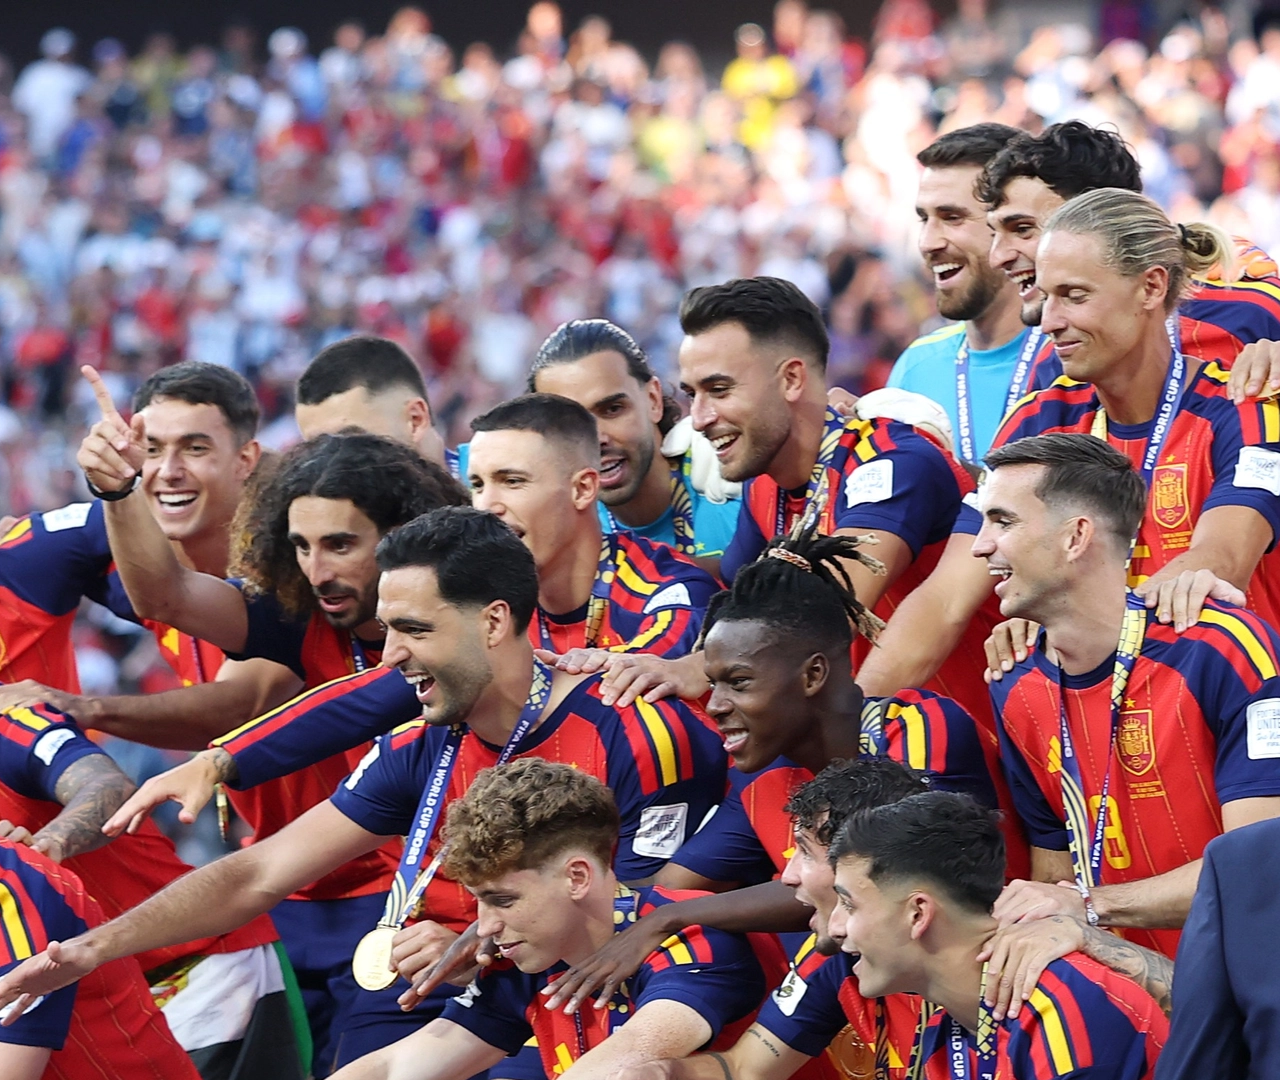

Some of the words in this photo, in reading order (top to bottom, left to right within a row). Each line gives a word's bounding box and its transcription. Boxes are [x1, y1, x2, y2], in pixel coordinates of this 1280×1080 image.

[1014, 362, 1028, 385] CUP
[958, 397, 969, 437] WORLD
[1144, 448, 1158, 471] FIFA
[1151, 404, 1172, 447] WORLD
[1165, 380, 1179, 404] CUP
[961, 438, 973, 460] CUP
[512, 720, 530, 745] FIFA
[438, 745, 455, 771] FIFA
[427, 770, 447, 806] WORLD
[419, 806, 434, 830] CUP
[406, 828, 426, 865] 2026
[1091, 841, 1102, 868] FIFA
[952, 1052, 965, 1078] CUP
